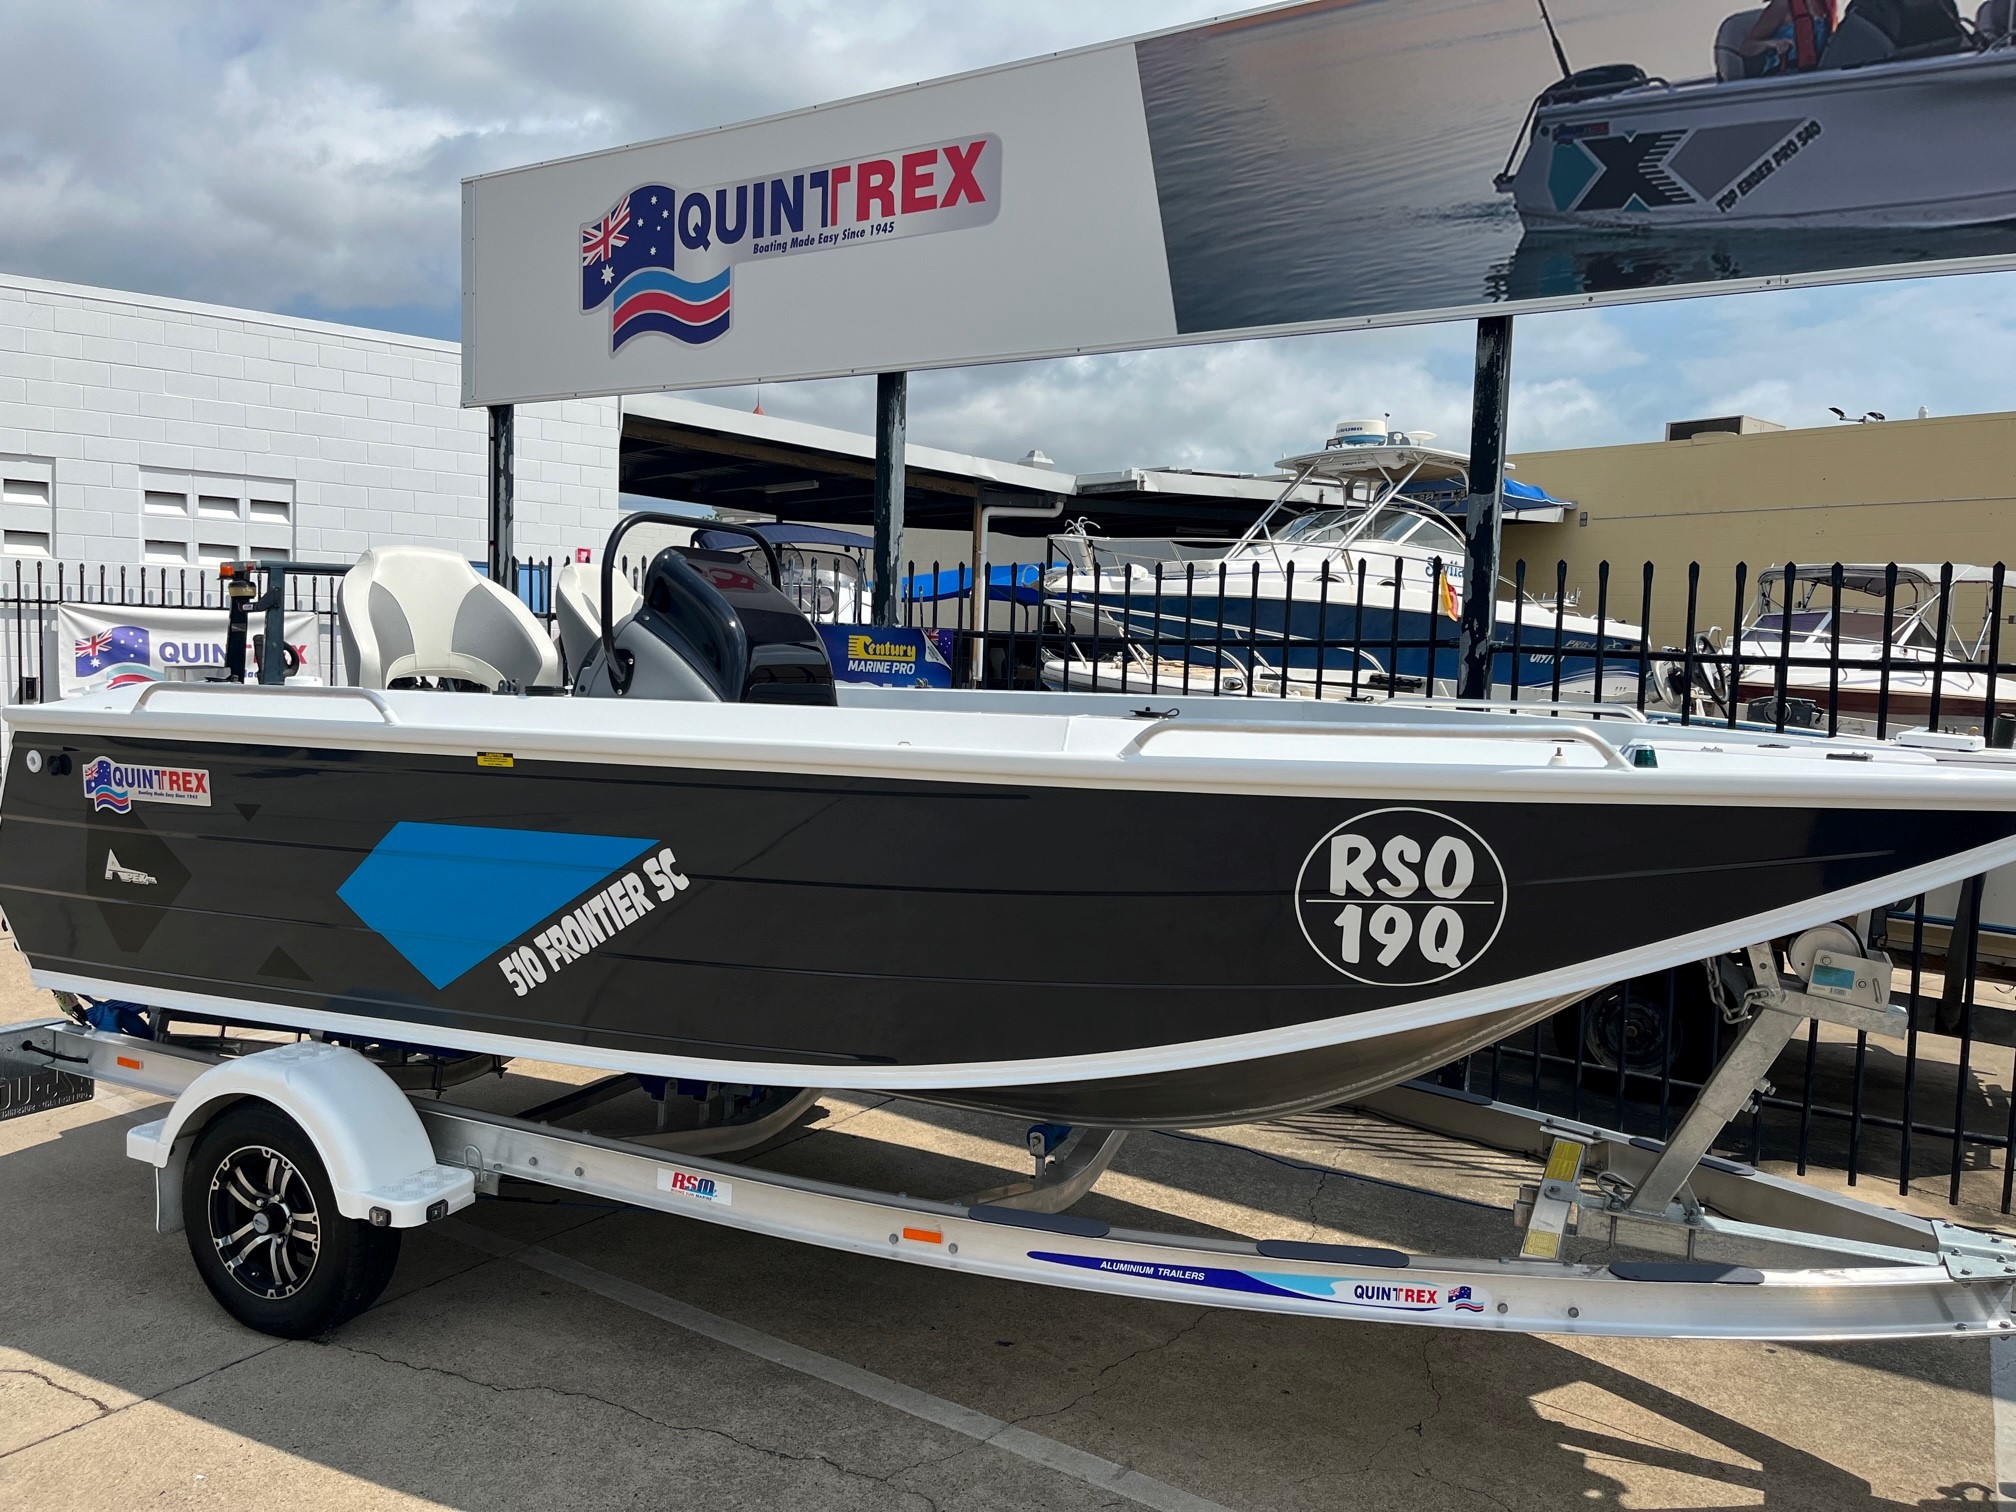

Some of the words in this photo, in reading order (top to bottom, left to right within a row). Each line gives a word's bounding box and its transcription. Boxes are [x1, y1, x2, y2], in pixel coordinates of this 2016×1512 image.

[678, 140, 987, 252] QUINTREX
[753, 240, 788, 254] Boating
[790, 234, 815, 249] Made
[817, 232, 840, 246] Easy
[842, 228, 866, 241] Since
[869, 221, 895, 236] 1945
[848, 635, 916, 662] Century
[847, 660, 891, 674] MARINE
[891, 661, 916, 675] PRO
[112, 766, 208, 794] QUINTREX
[498, 945, 548, 997] 510
[533, 871, 656, 973] FRONTIER
[642, 847, 691, 902] SC
[1333, 903, 1465, 969] 19Q
[1100, 1260, 1154, 1275] ALUMINIUM
[1157, 1267, 1205, 1281] TRAILERS
[1354, 1284, 1438, 1305] QUINTREX
